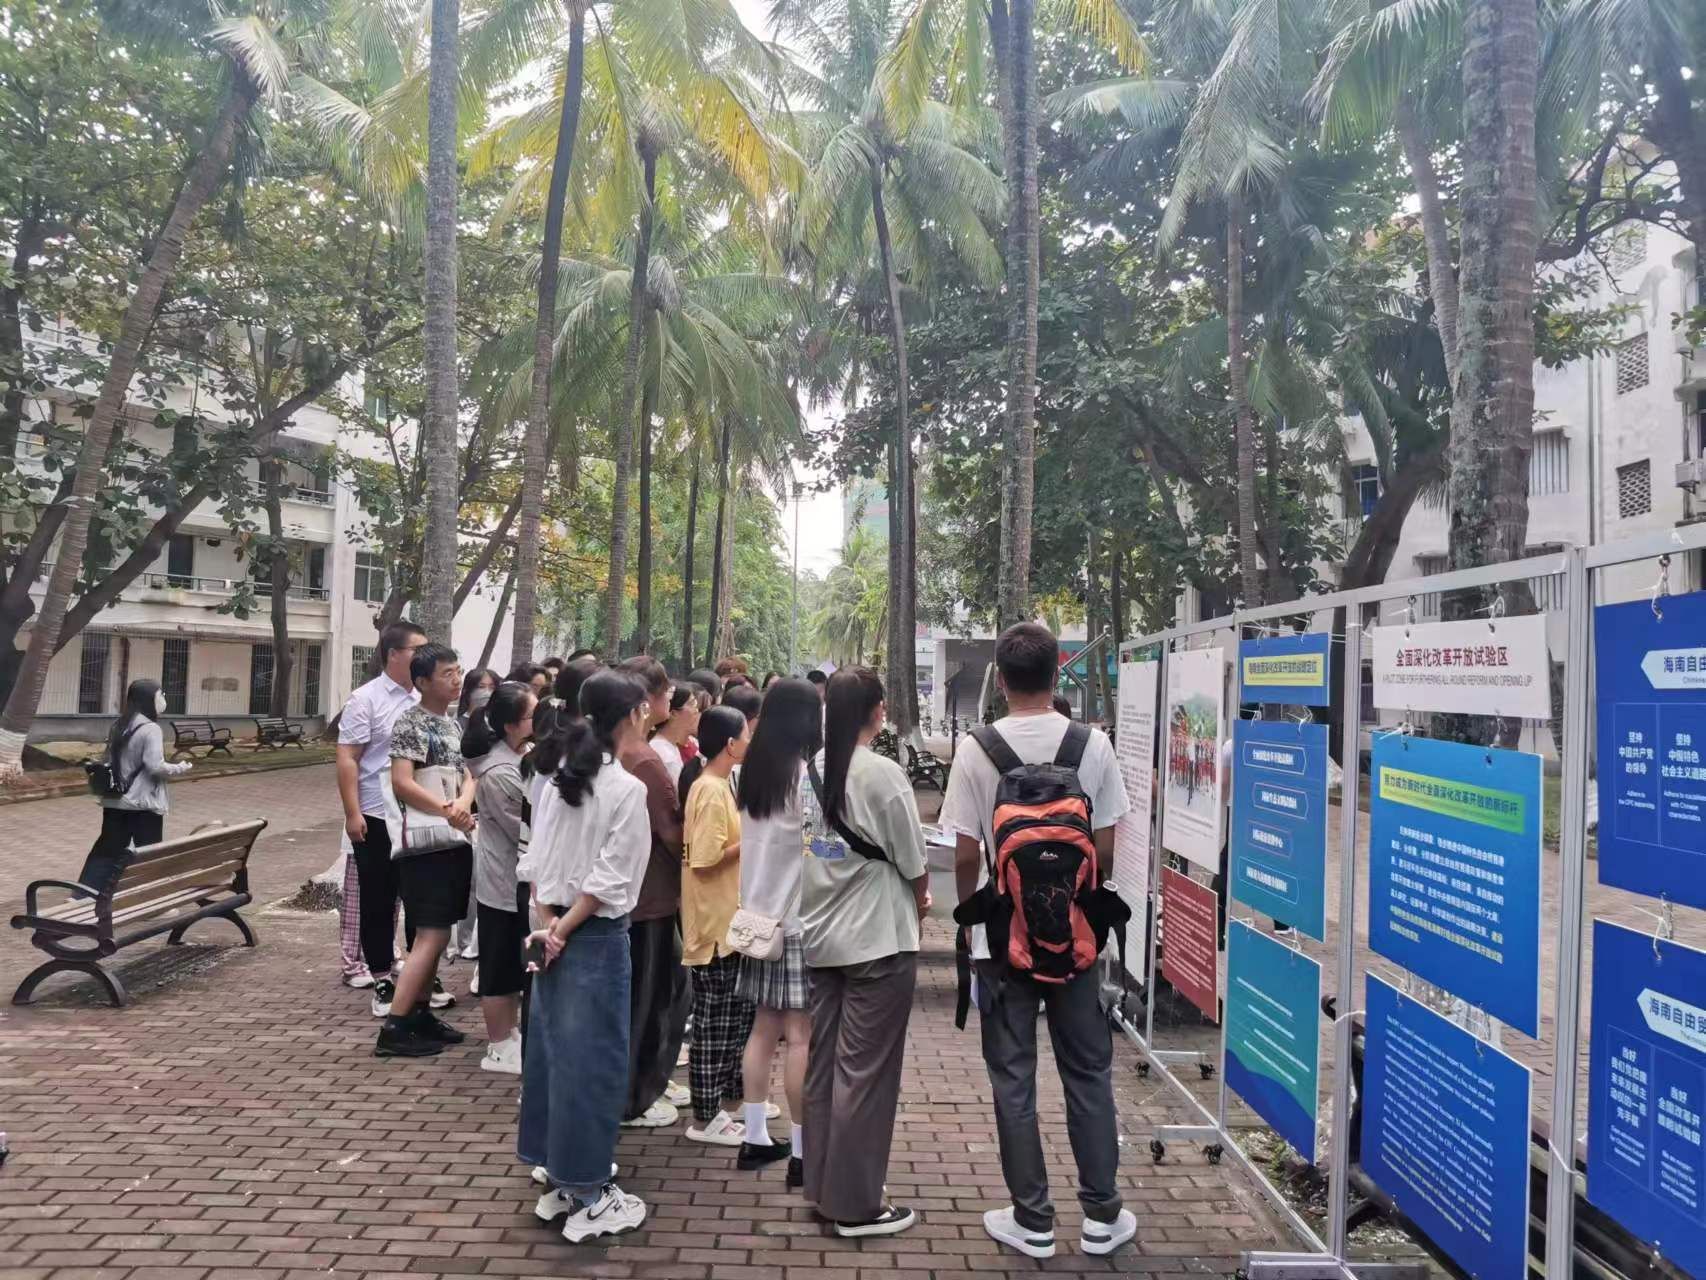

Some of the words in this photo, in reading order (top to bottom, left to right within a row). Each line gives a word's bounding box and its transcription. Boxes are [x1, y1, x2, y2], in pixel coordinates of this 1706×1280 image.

[1396, 646, 1509, 667] 全面深化改革开放试验区
[1663, 655, 1706, 673] 海南自由
[1618, 746, 1654, 760] 中国共产党
[1668, 749, 1699, 763] 中国特色
[1625, 762, 1647, 775] 的领导
